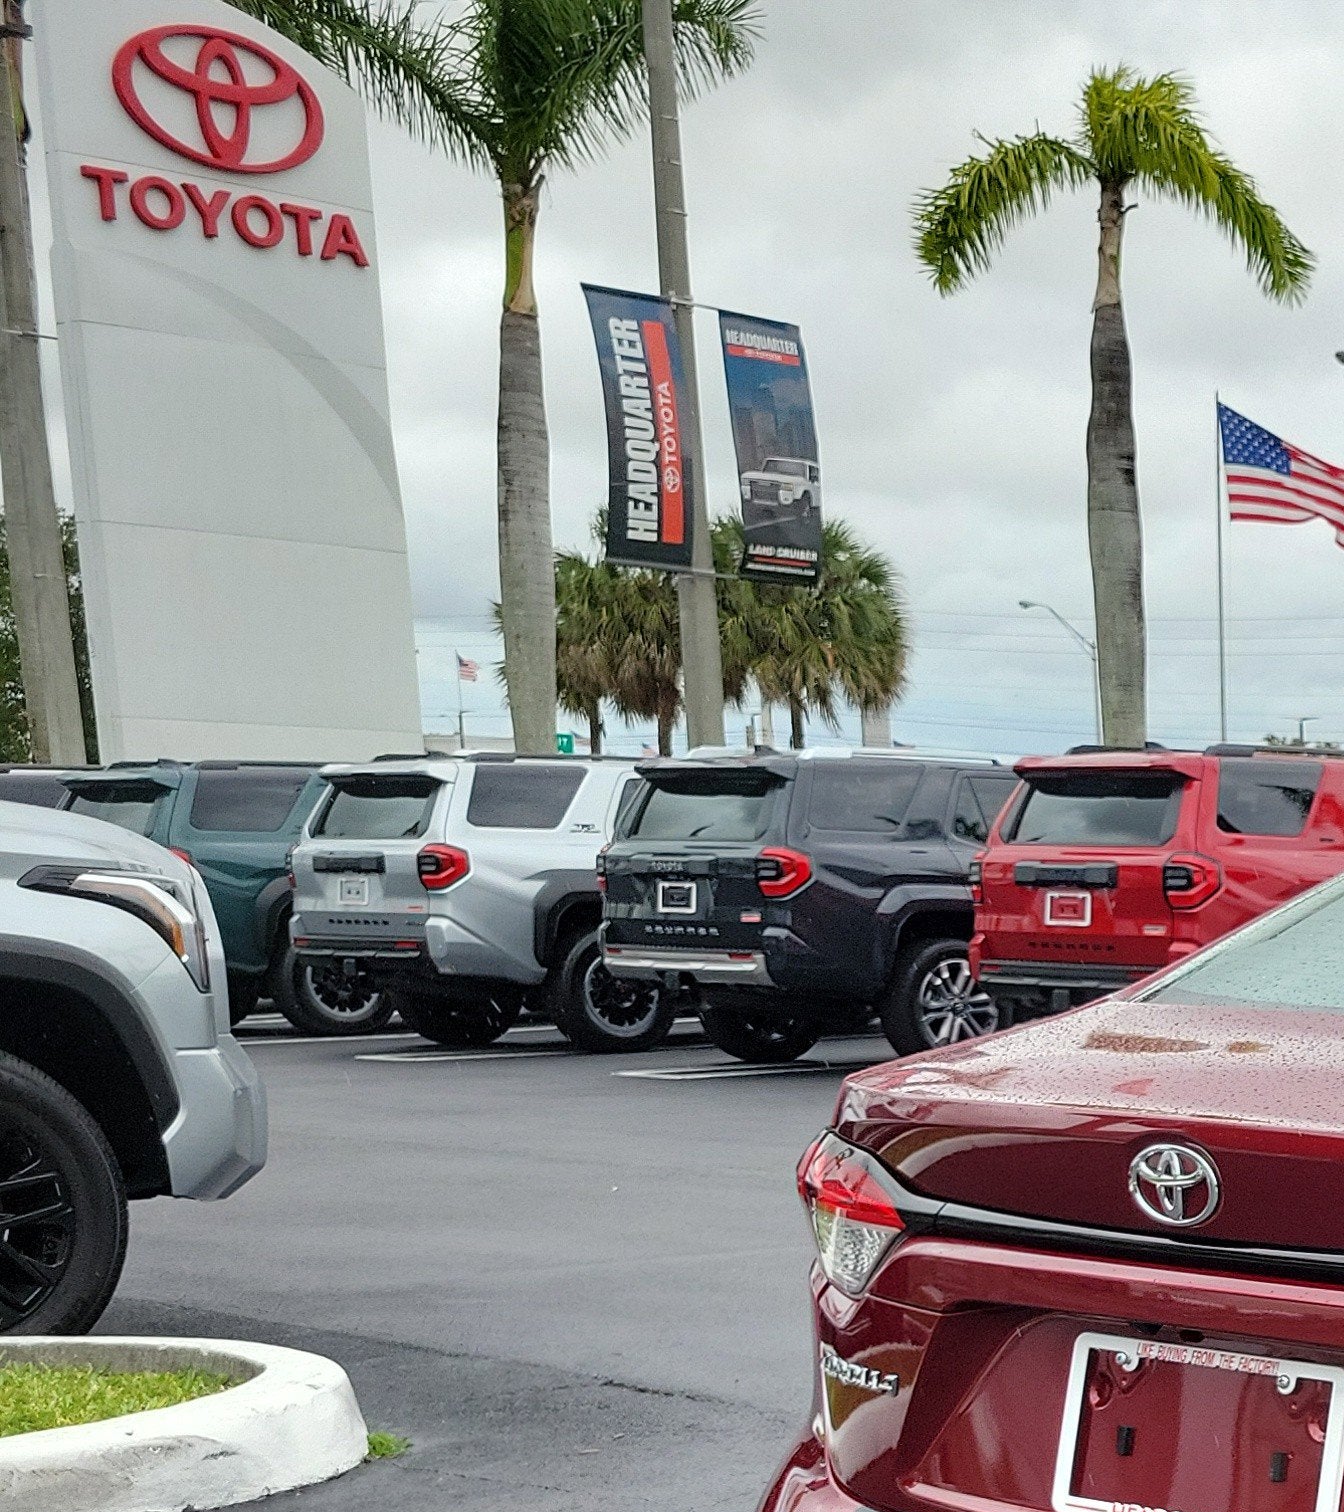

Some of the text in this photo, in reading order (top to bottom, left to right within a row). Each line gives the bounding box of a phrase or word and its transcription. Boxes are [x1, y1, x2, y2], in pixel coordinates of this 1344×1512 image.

[80, 164, 370, 268] TOYOTA
[609, 316, 660, 542] HEADQUARTER
[657, 381, 677, 465] TOYOTA
[1157, 1345, 1188, 1363] BUYING
[1191, 1350, 1217, 1368] FROM
[1219, 1353, 1235, 1370] THE
